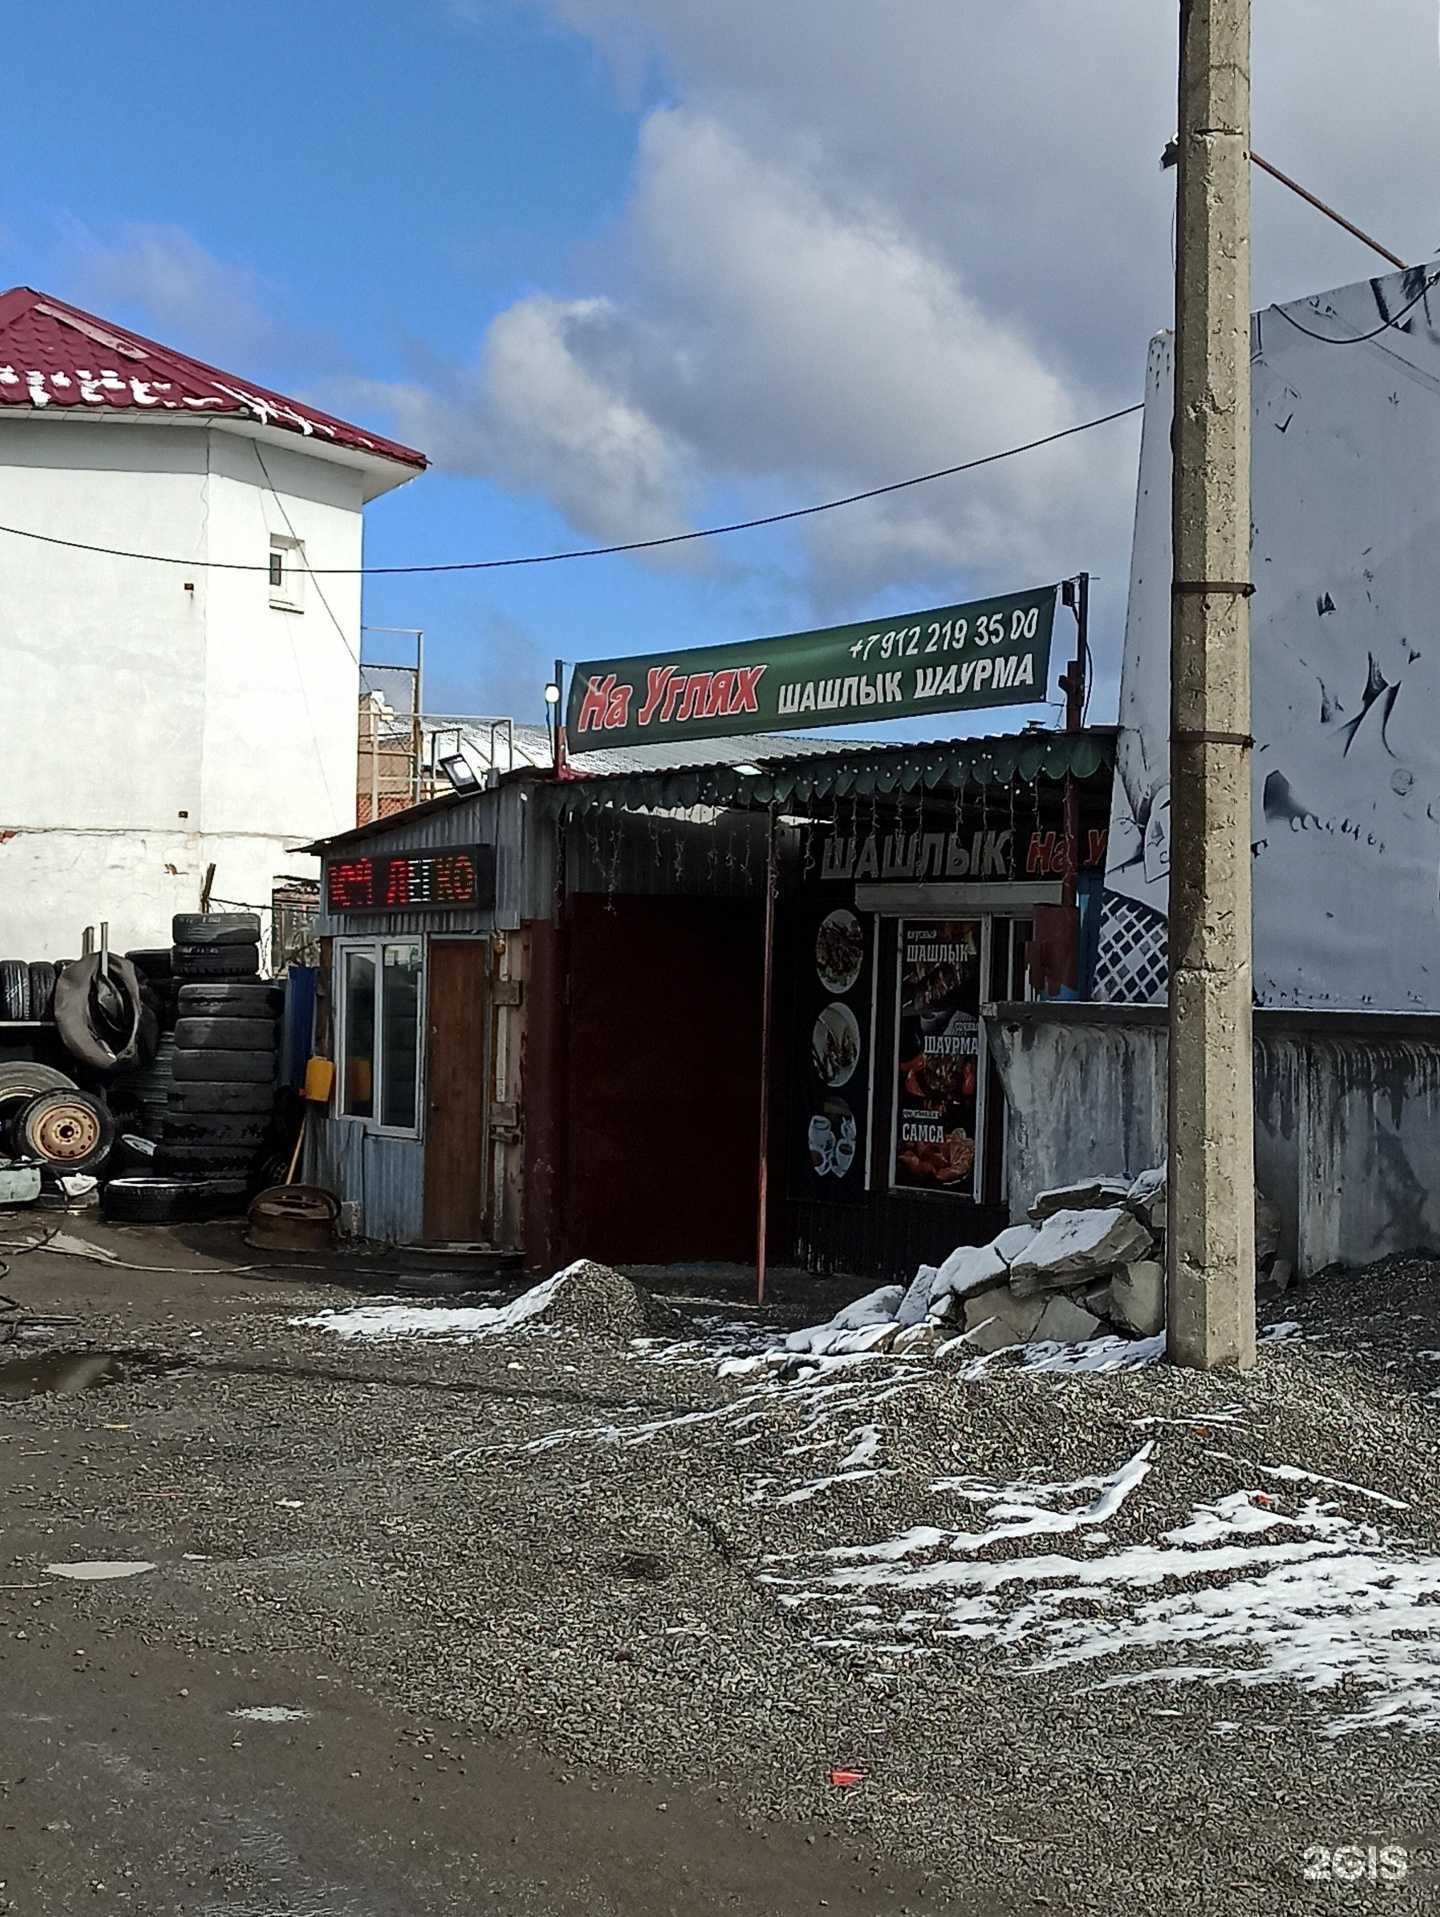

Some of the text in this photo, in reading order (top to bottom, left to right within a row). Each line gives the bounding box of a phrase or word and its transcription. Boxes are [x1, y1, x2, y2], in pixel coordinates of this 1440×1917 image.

[850, 607, 1040, 662] +7 912 219 35 00
[578, 674, 634, 732] На
[777, 653, 1034, 715] ШАШЛЫК ШАУРМА
[820, 829, 1013, 880] ШАШЛЫК
[906, 944, 969, 963] ШАШЛЫК
[924, 1036, 979, 1056] ШАУРМА
[902, 1123, 945, 1144] САМСА
